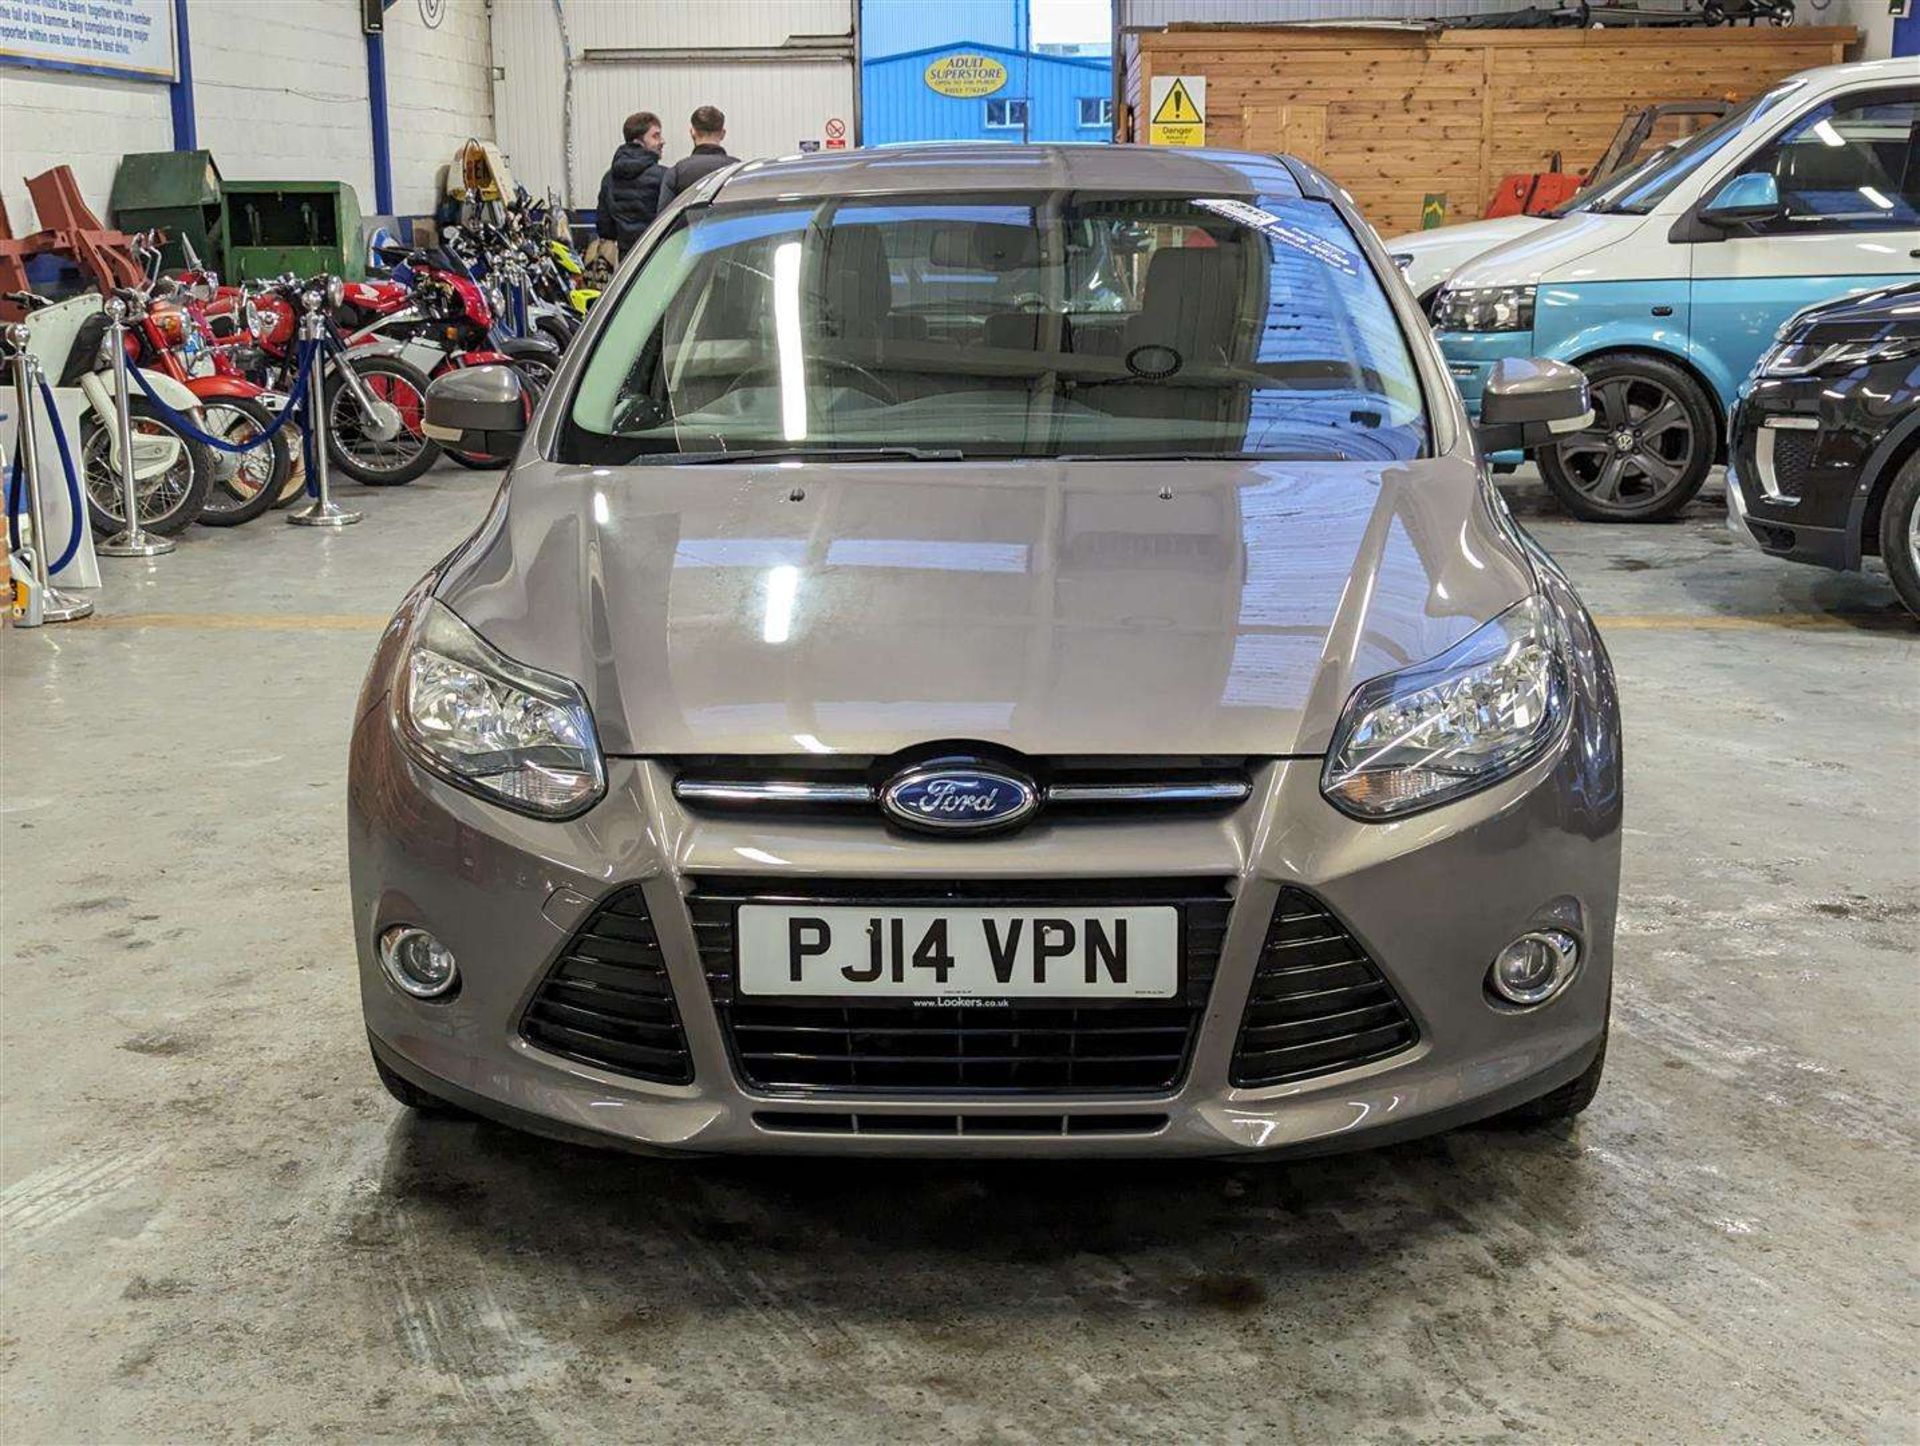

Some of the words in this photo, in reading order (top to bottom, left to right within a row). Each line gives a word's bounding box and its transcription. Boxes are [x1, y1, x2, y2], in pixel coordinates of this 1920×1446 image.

[88, 4, 112, 20] together
[113, 9, 126, 21] with
[130, 12, 152, 25] member
[946, 58, 984, 68] ADULT
[930, 68, 1002, 80] SUPERSTORE
[1162, 126, 1193, 135] Danger
[917, 780, 999, 812] Ford
[789, 917, 955, 983] PJ14
[982, 918, 1127, 983] VPN
[912, 996, 1009, 1009] www.Lookers.co.uk
